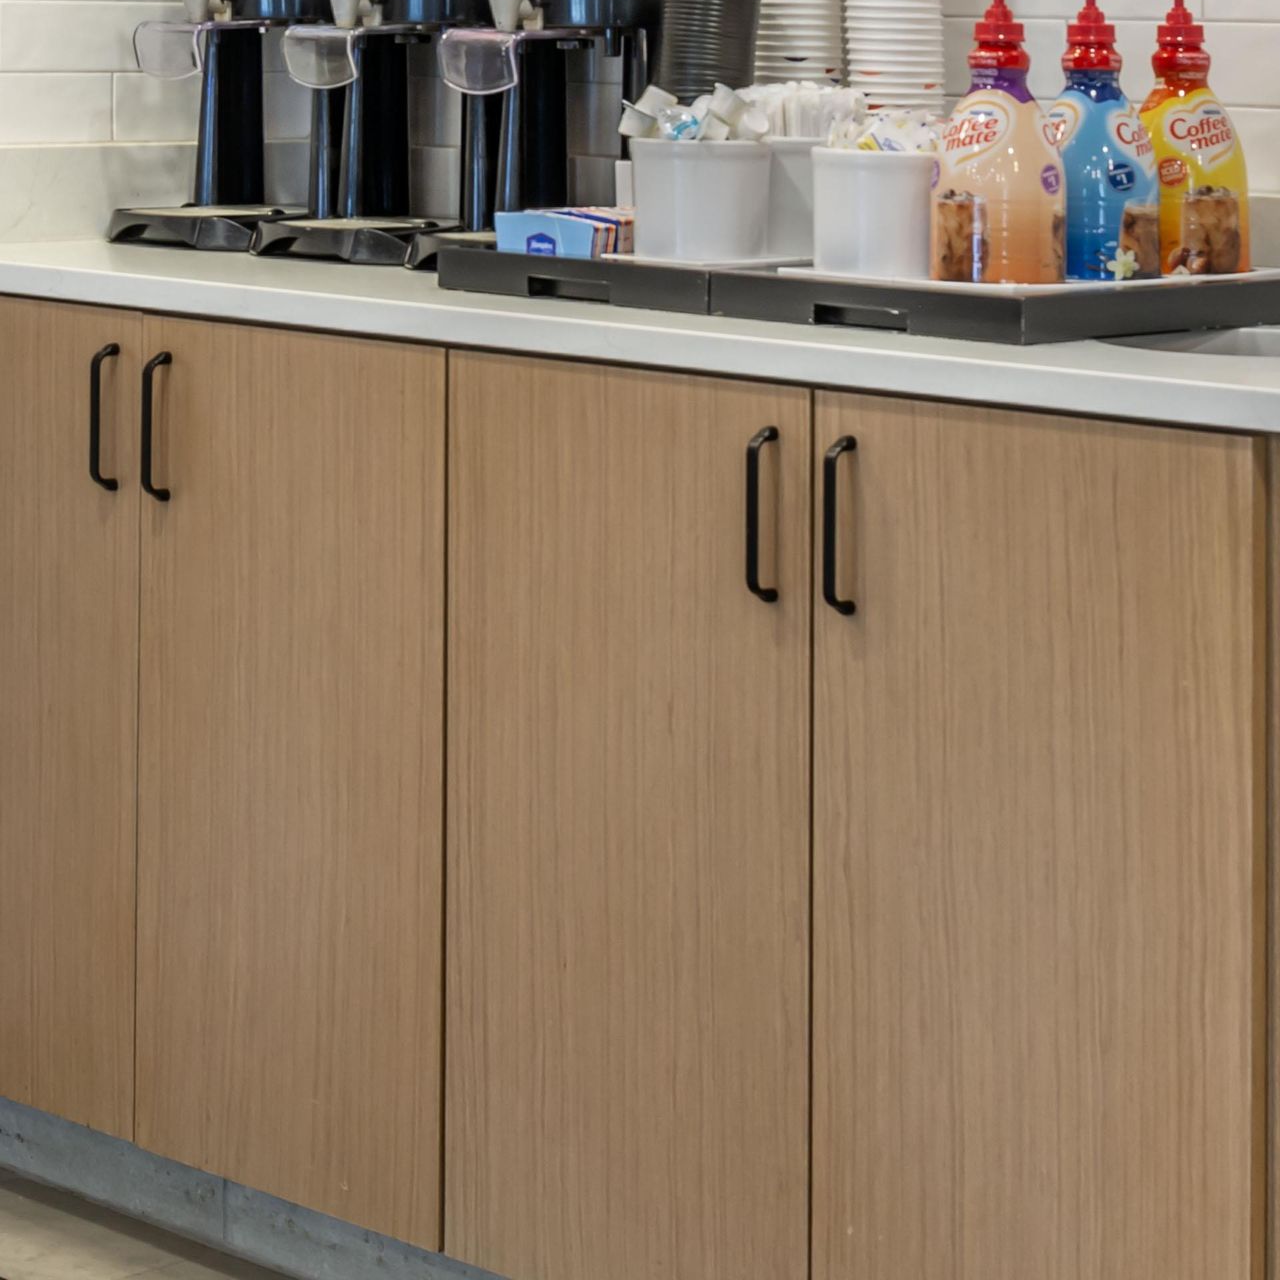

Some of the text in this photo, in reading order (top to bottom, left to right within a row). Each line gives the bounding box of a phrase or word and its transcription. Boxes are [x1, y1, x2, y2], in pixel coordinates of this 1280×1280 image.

[1169, 116, 1228, 141] Coffee
[1190, 127, 1232, 151] mate
[945, 131, 996, 152] mate
